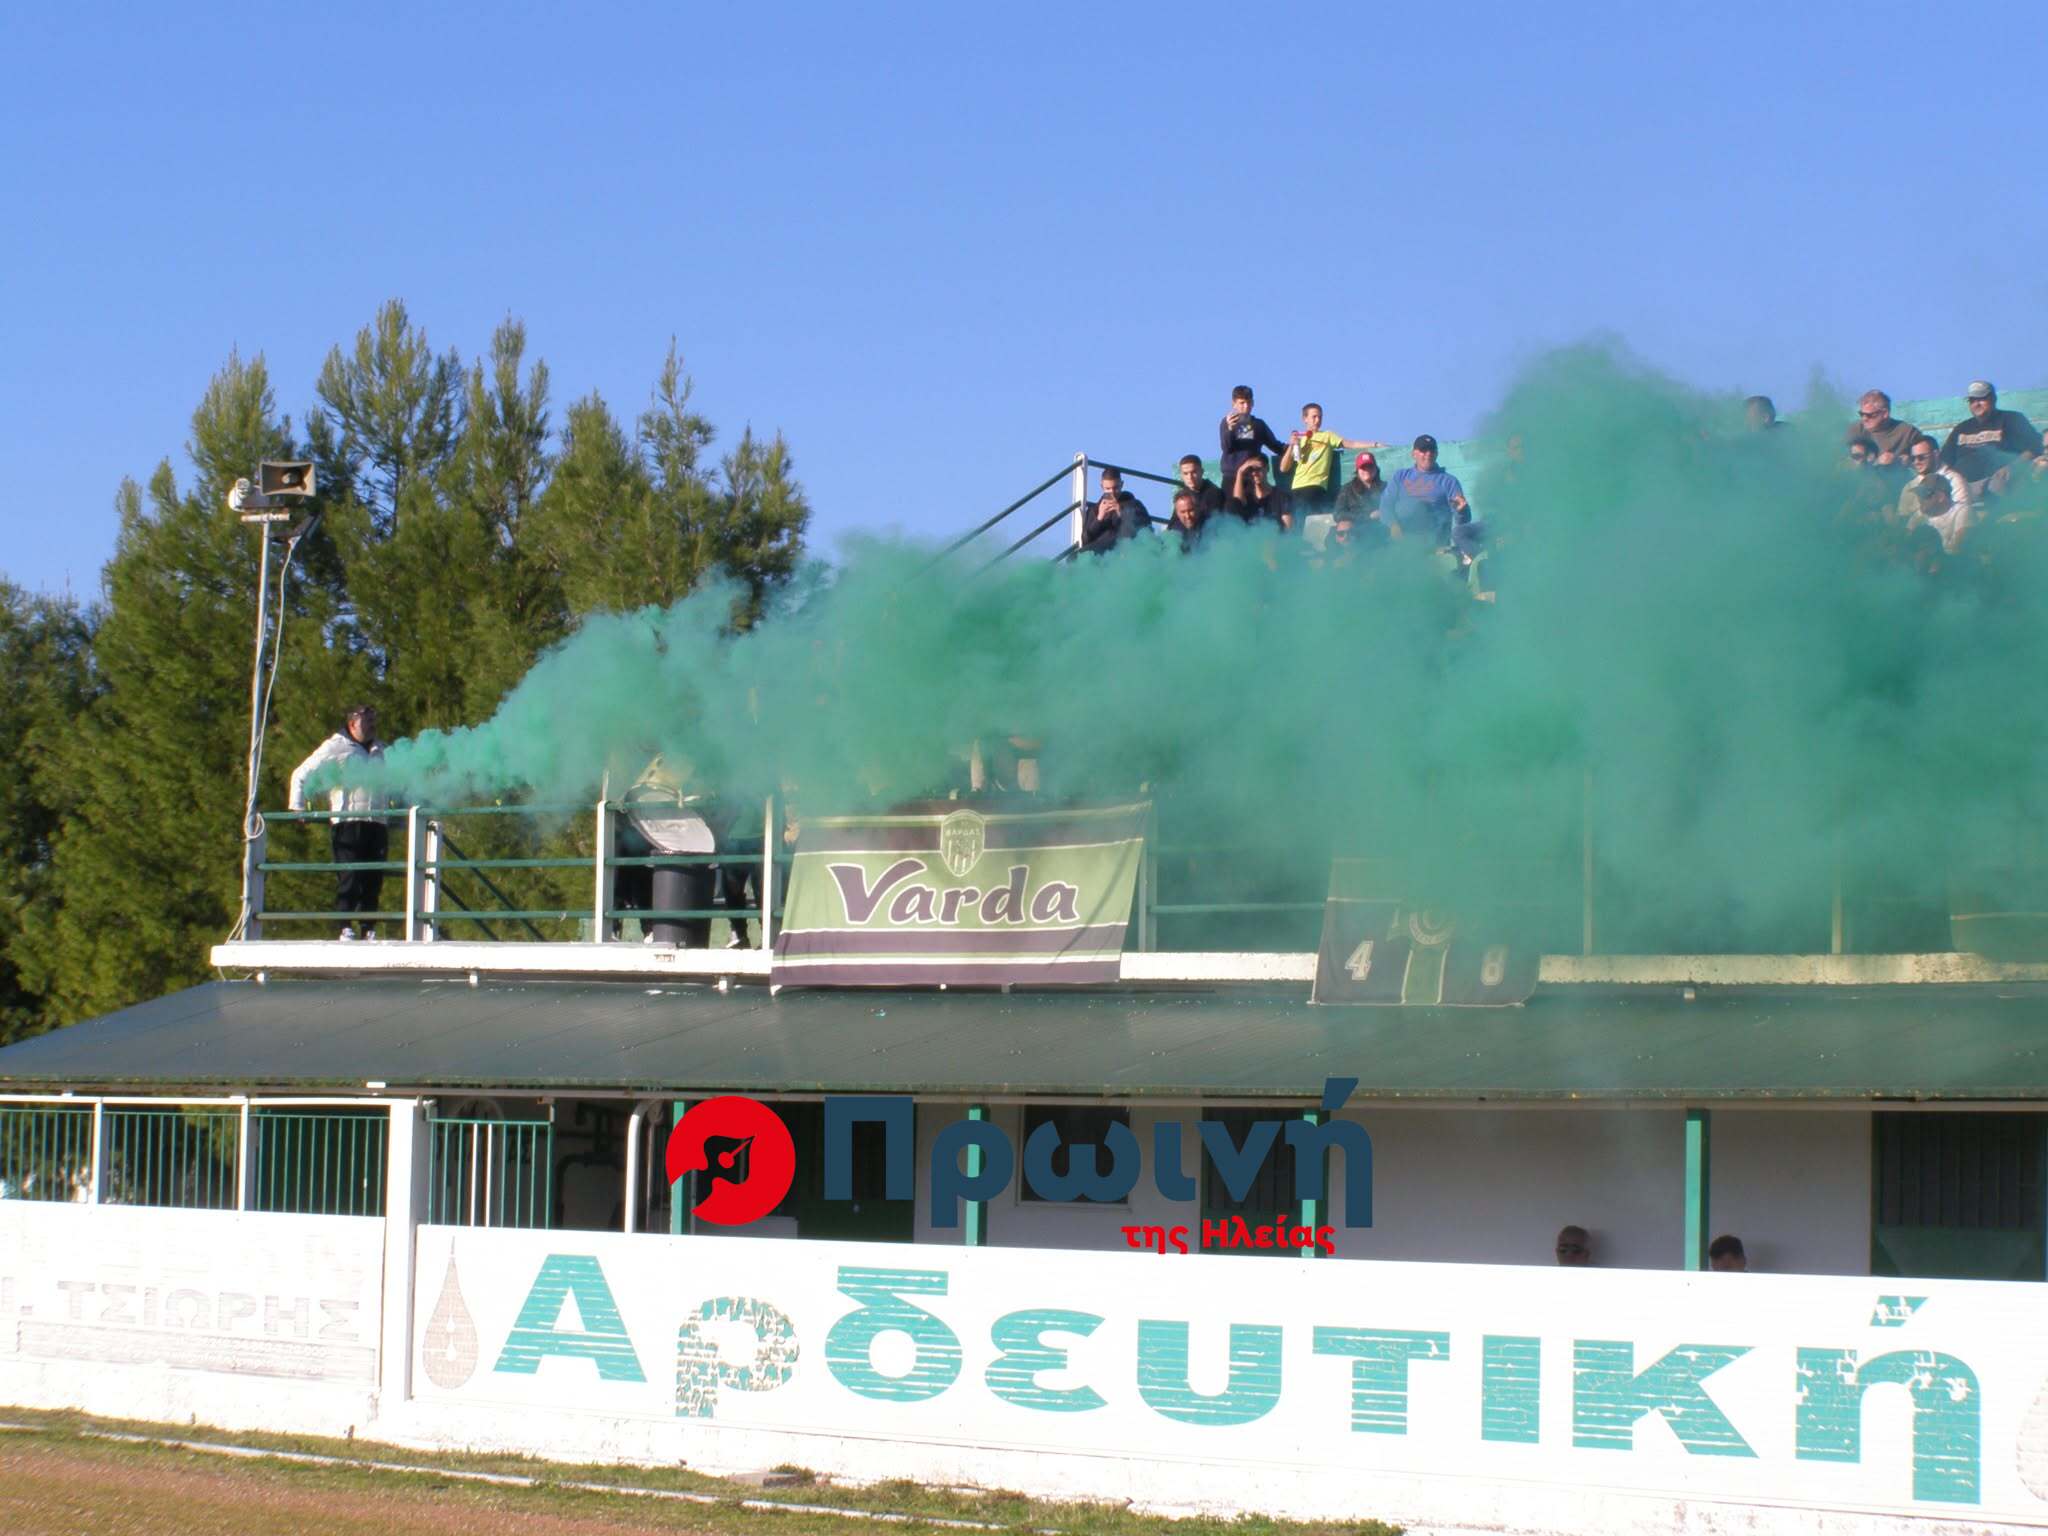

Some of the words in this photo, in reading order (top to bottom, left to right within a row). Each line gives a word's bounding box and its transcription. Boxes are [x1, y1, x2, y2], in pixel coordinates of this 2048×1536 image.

[826, 858, 1080, 925] Varda
[1344, 940, 1374, 981] 4
[56, 1279, 361, 1342] ΤΣΙΩΡΗΣ
[493, 1254, 1981, 1506] Αρδευτική
